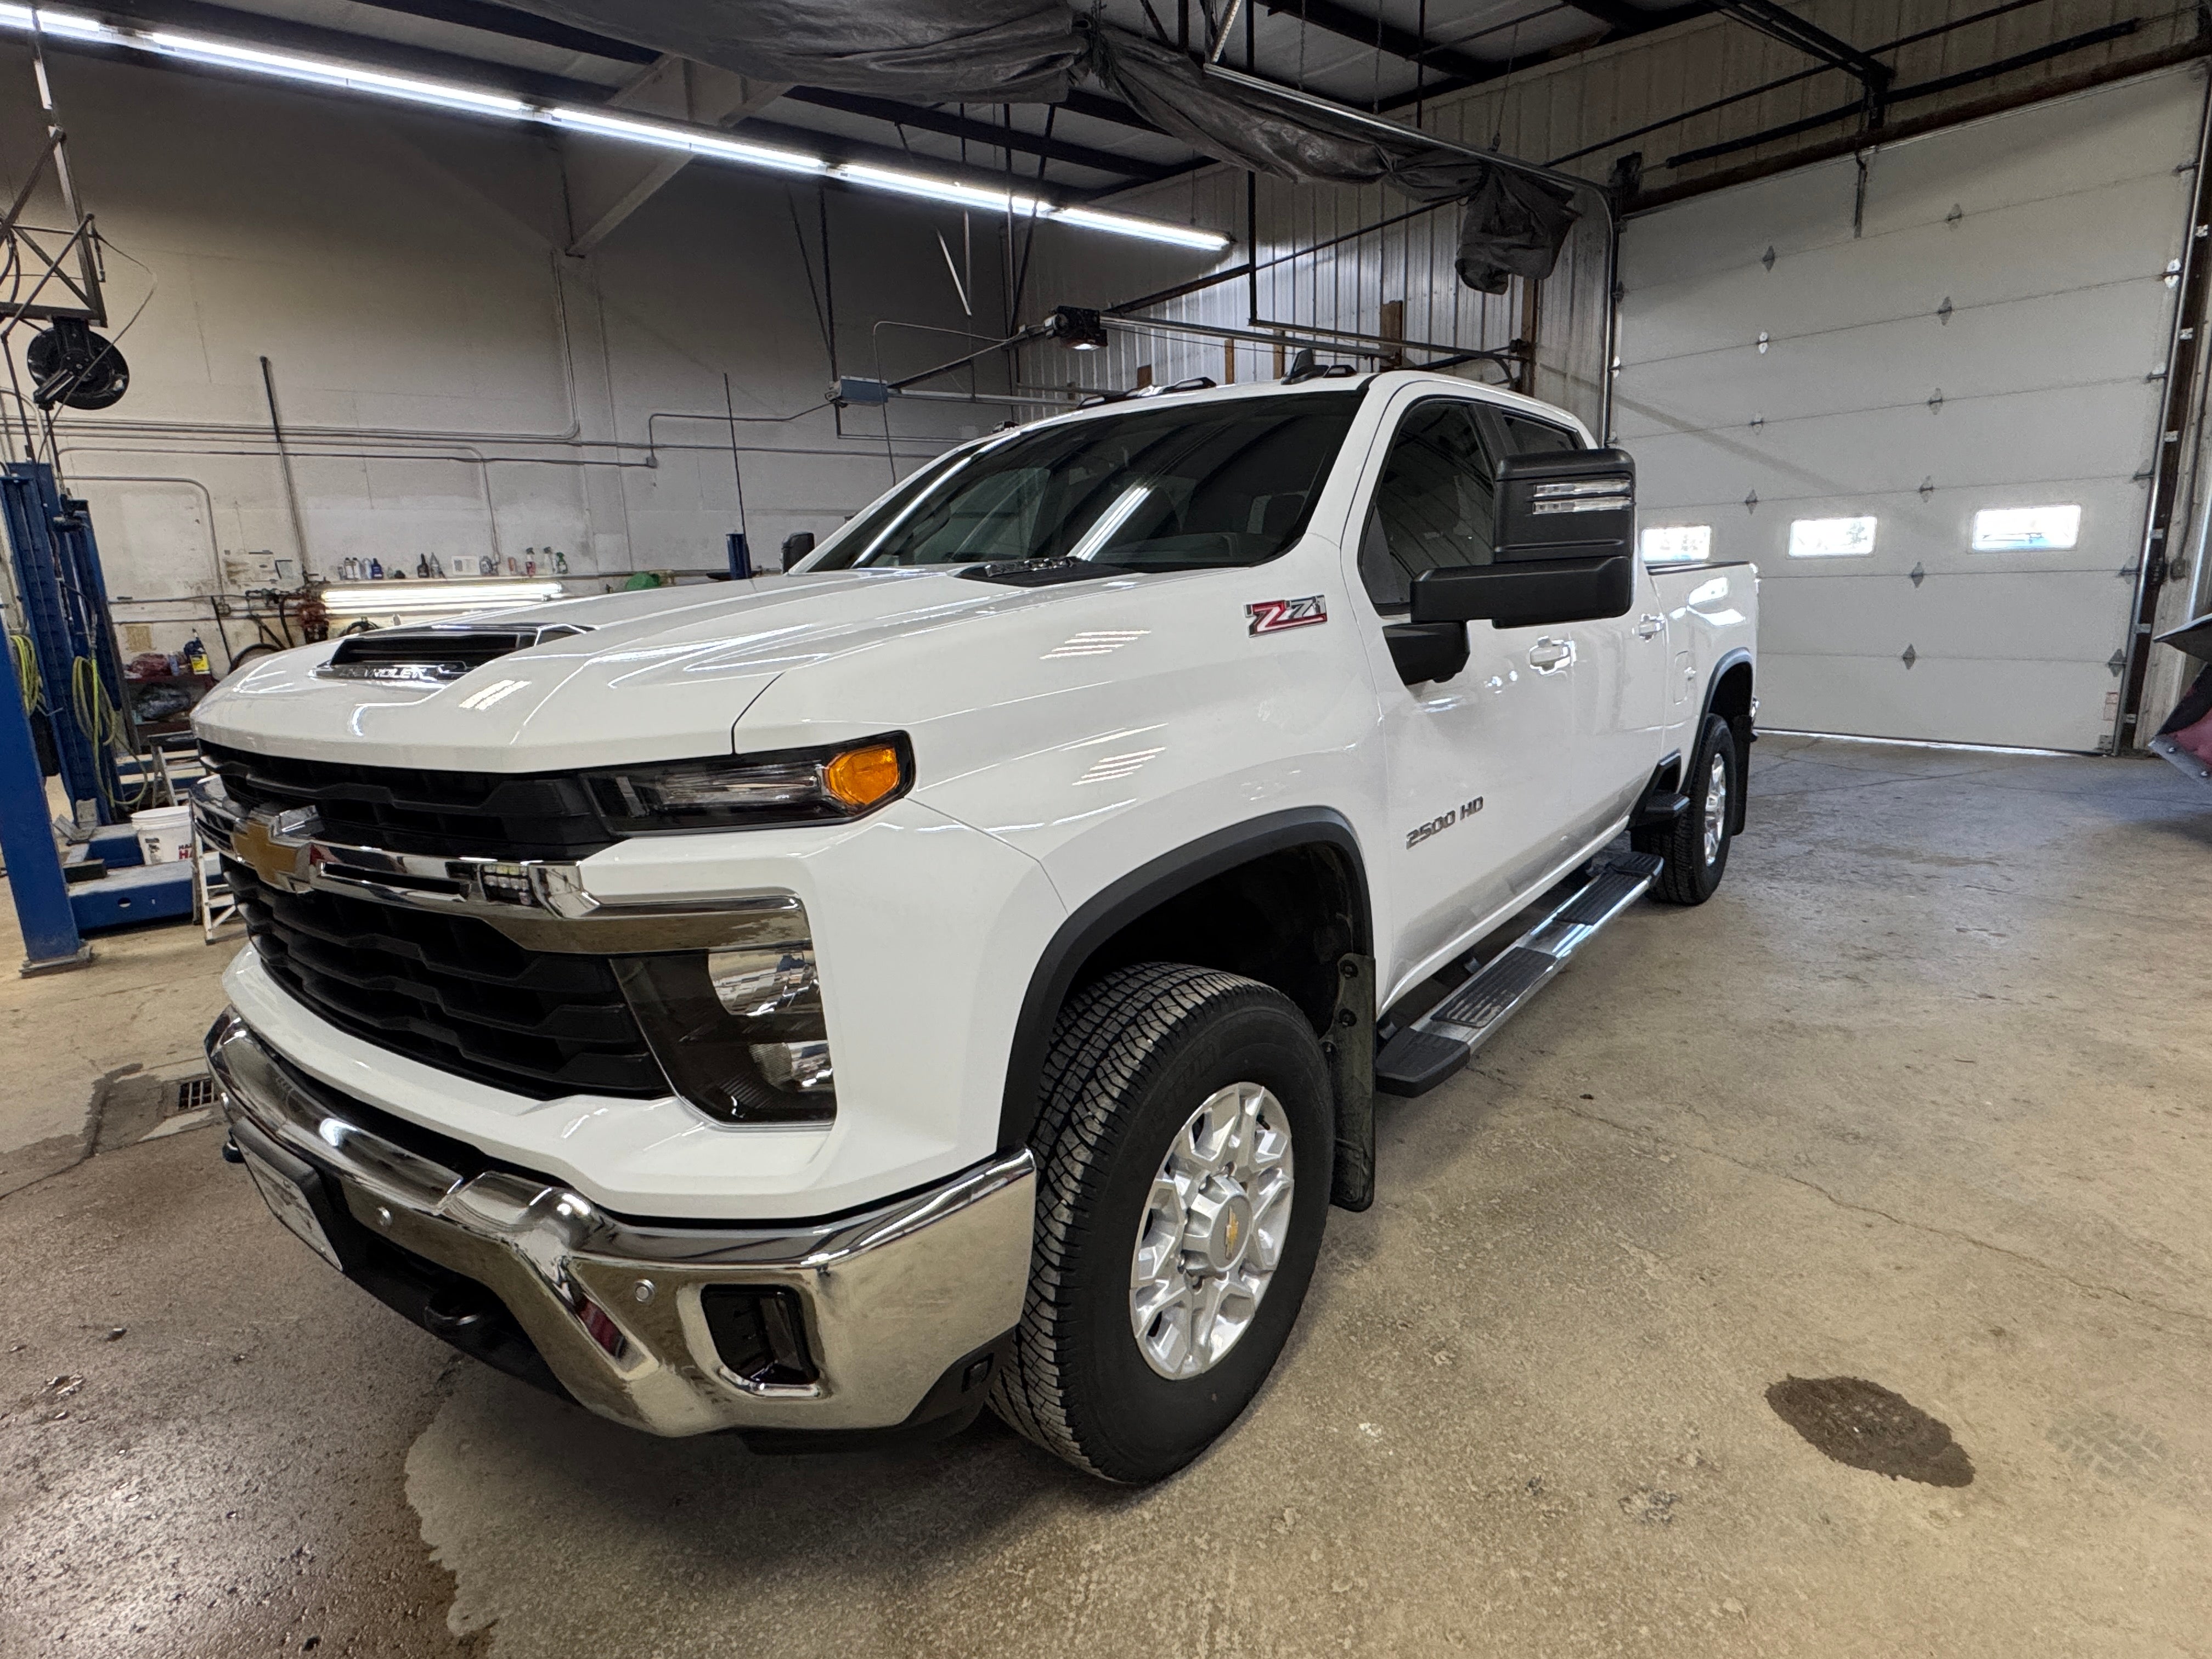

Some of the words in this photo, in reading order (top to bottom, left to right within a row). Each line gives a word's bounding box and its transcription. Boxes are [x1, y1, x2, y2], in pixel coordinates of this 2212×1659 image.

[1244, 595, 1328, 637] Z71
[1406, 810, 1455, 850] 2500
[1459, 795, 1483, 820] HD
